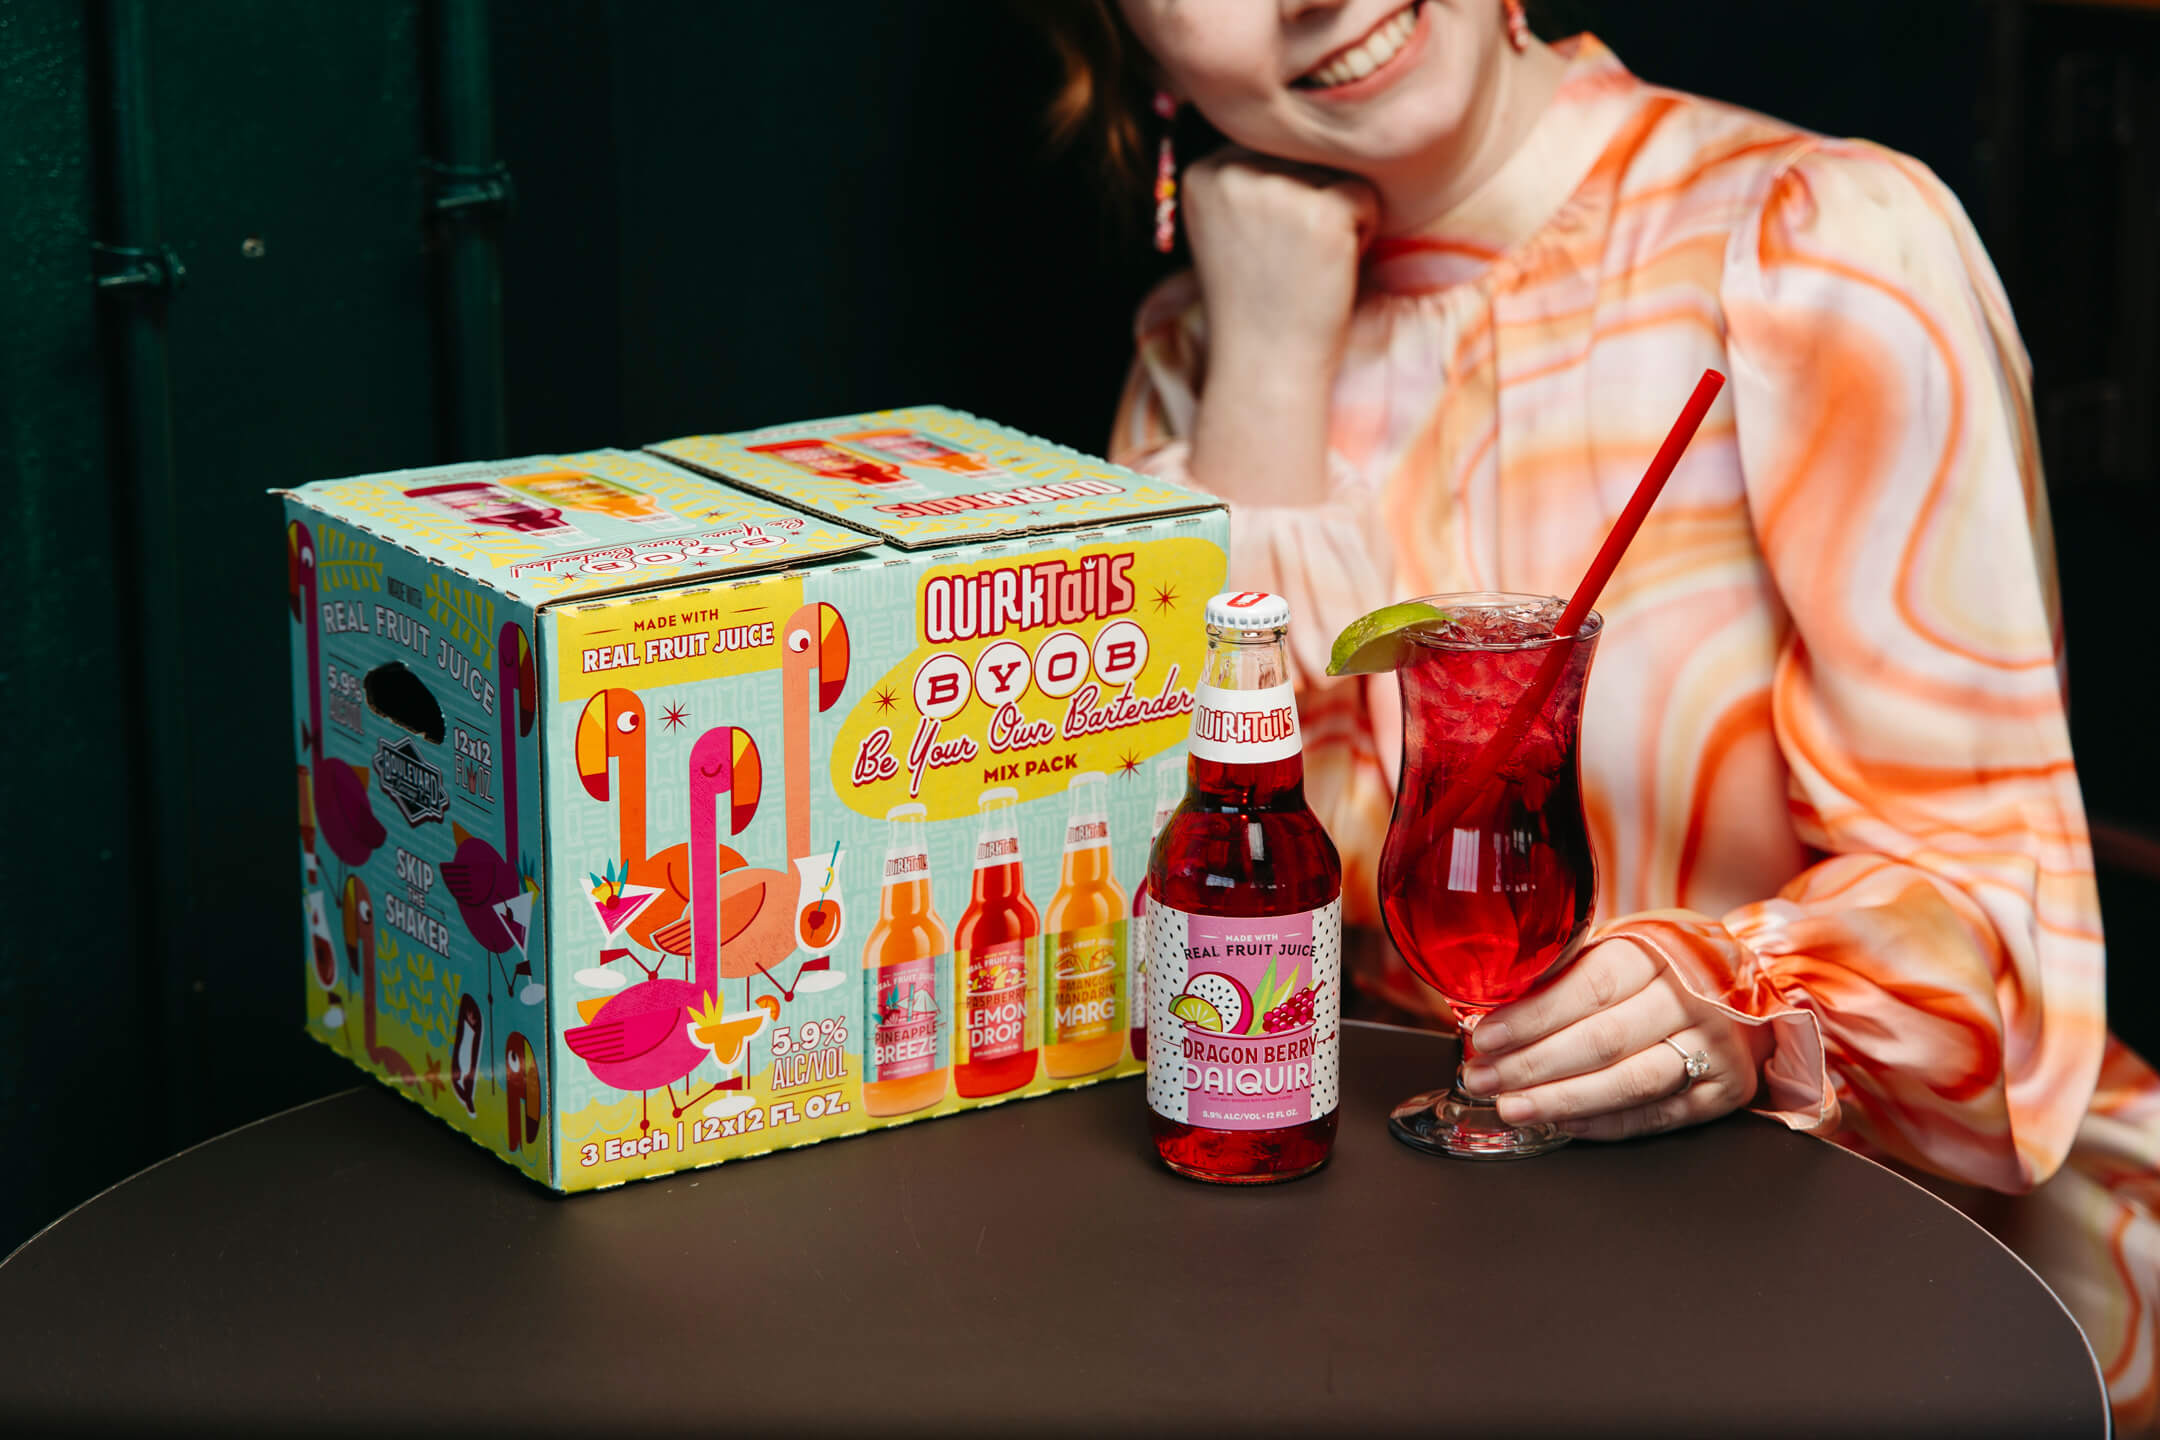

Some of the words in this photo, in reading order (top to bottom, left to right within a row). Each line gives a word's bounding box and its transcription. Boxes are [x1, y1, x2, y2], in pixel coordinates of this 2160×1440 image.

[585, 535, 784, 573] BYOB
[633, 614, 677, 633] MADE
[680, 608, 719, 625] WITH
[321, 602, 370, 635] REAL
[374, 603, 431, 658] FRUIT
[437, 637, 496, 716] JUICE
[582, 642, 641, 673] REAL
[645, 632, 710, 664] FRUIT
[712, 621, 775, 653] JUICE
[924, 637, 1140, 710] BYOB
[453, 726, 493, 768] 12x12
[852, 728, 899, 786] Be
[908, 717, 978, 798] Your
[988, 702, 1056, 753] Own
[1062, 664, 1197, 740] Bartender
[983, 760, 1019, 783] MIX
[1025, 753, 1078, 776] PACK
[396, 846, 434, 896] SKIP
[407, 886, 426, 910] THE
[385, 892, 450, 959] SHAKER
[1225, 934, 1253, 943] MADE
[1254, 933, 1279, 942] WITH
[1183, 945, 1220, 960] REAL
[1226, 944, 1273, 957] FRUIT
[1278, 944, 1317, 958] JUICE
[966, 1001, 1027, 1030] LEMON
[1055, 998, 1116, 1030] MARG
[771, 1015, 848, 1056] 5.9%
[874, 1035, 937, 1067] BREEZE
[971, 1020, 1022, 1049] DROP
[1183, 1036, 1259, 1065] DRAGON
[1263, 1033, 1318, 1064] BERRY
[771, 1045, 848, 1091] ALC/VOL
[580, 1143, 599, 1168] 3
[604, 1129, 670, 1163] Each
[693, 1108, 765, 1145] 12x12
[770, 1100, 801, 1128] FL
[805, 1090, 850, 1120] OZ.
